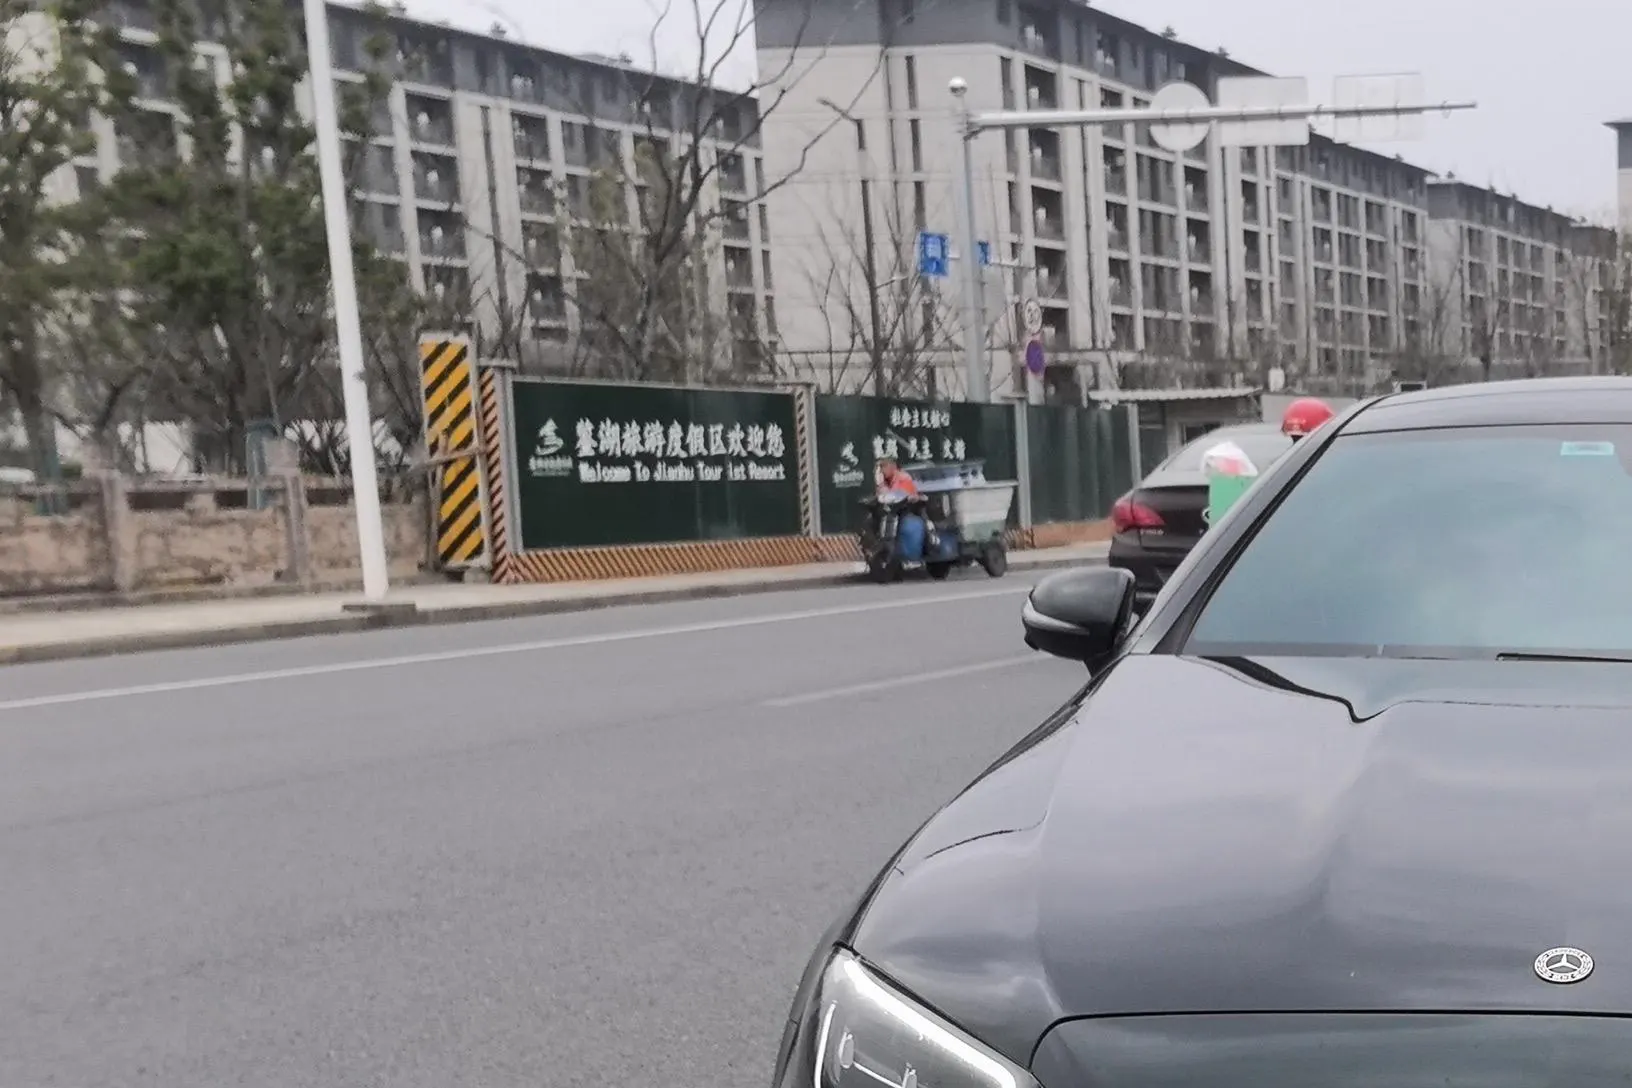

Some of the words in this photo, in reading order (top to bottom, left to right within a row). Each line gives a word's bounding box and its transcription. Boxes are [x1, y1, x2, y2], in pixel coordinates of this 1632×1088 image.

[575, 417, 786, 458] 鉴湖旅游度假区欢迎您
[578, 461, 632, 482] Welcome
[633, 461, 650, 481] To
[652, 460, 695, 481] Jianhu
[697, 460, 723, 481] Tour
[748, 460, 786, 480] Resort
